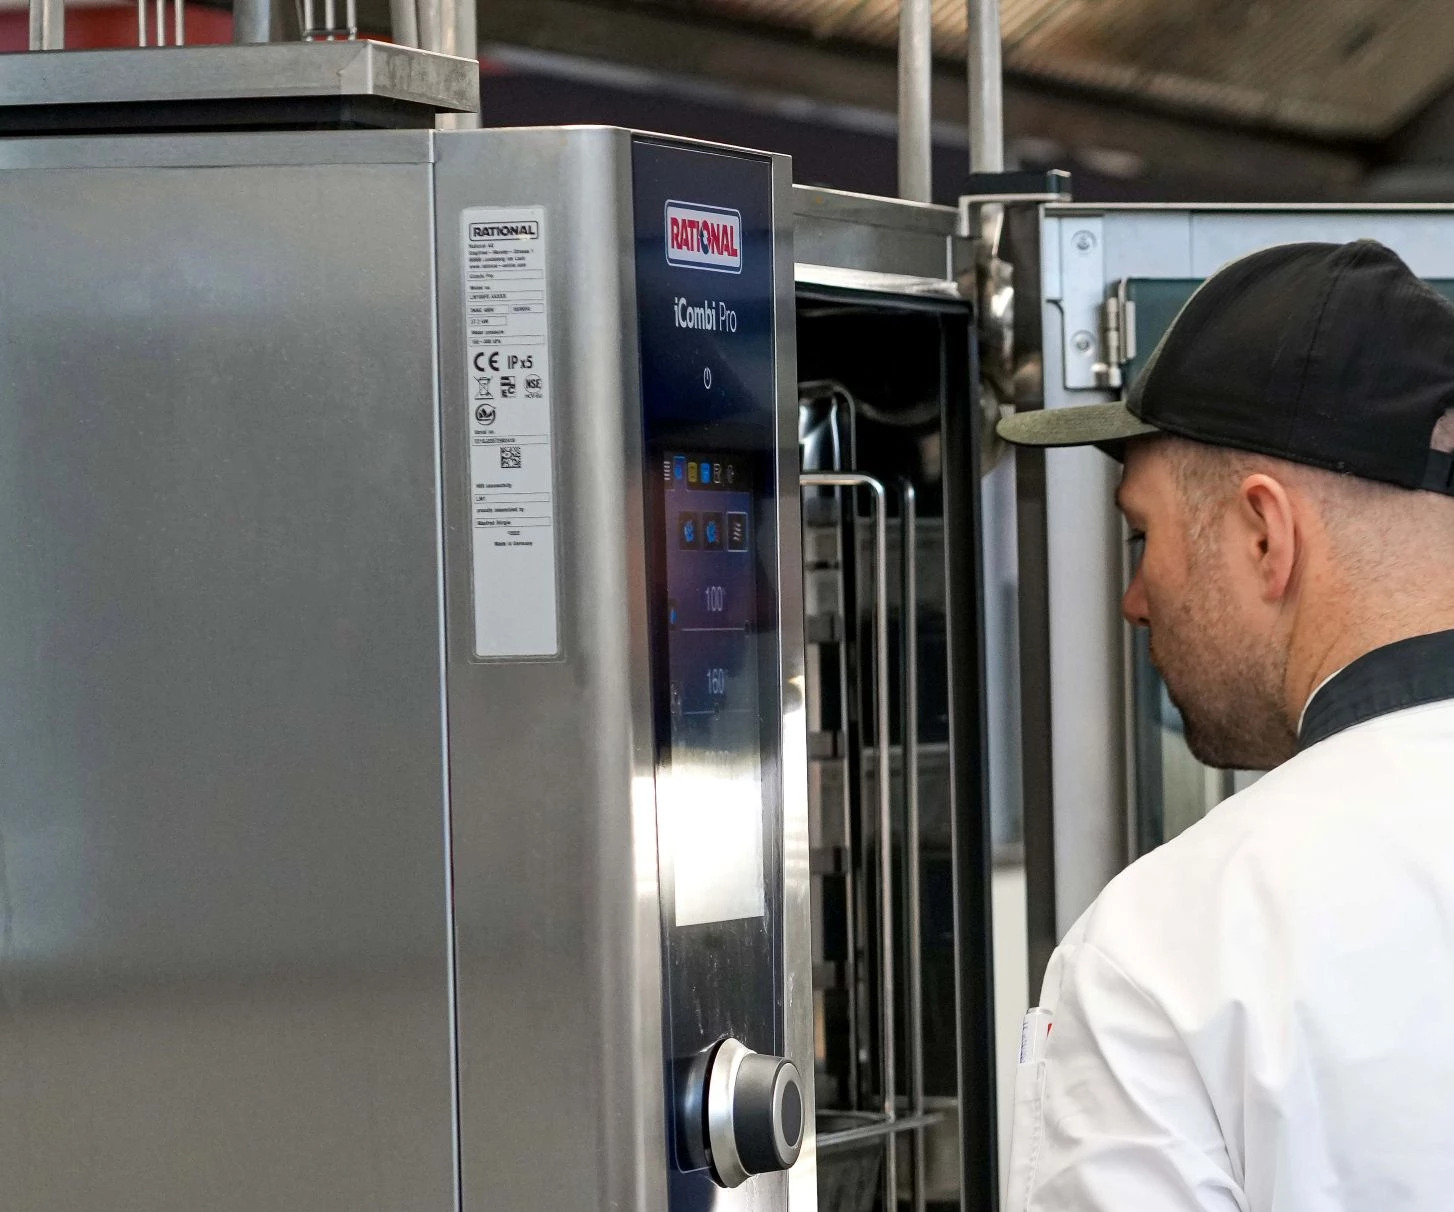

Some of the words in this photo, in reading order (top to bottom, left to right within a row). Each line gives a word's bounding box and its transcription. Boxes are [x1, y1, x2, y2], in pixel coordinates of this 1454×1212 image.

[472, 225, 535, 238] RATIONAL
[670, 216, 738, 257] RATIONAL
[674, 296, 716, 331] iCombi
[719, 301, 737, 333] Pro
